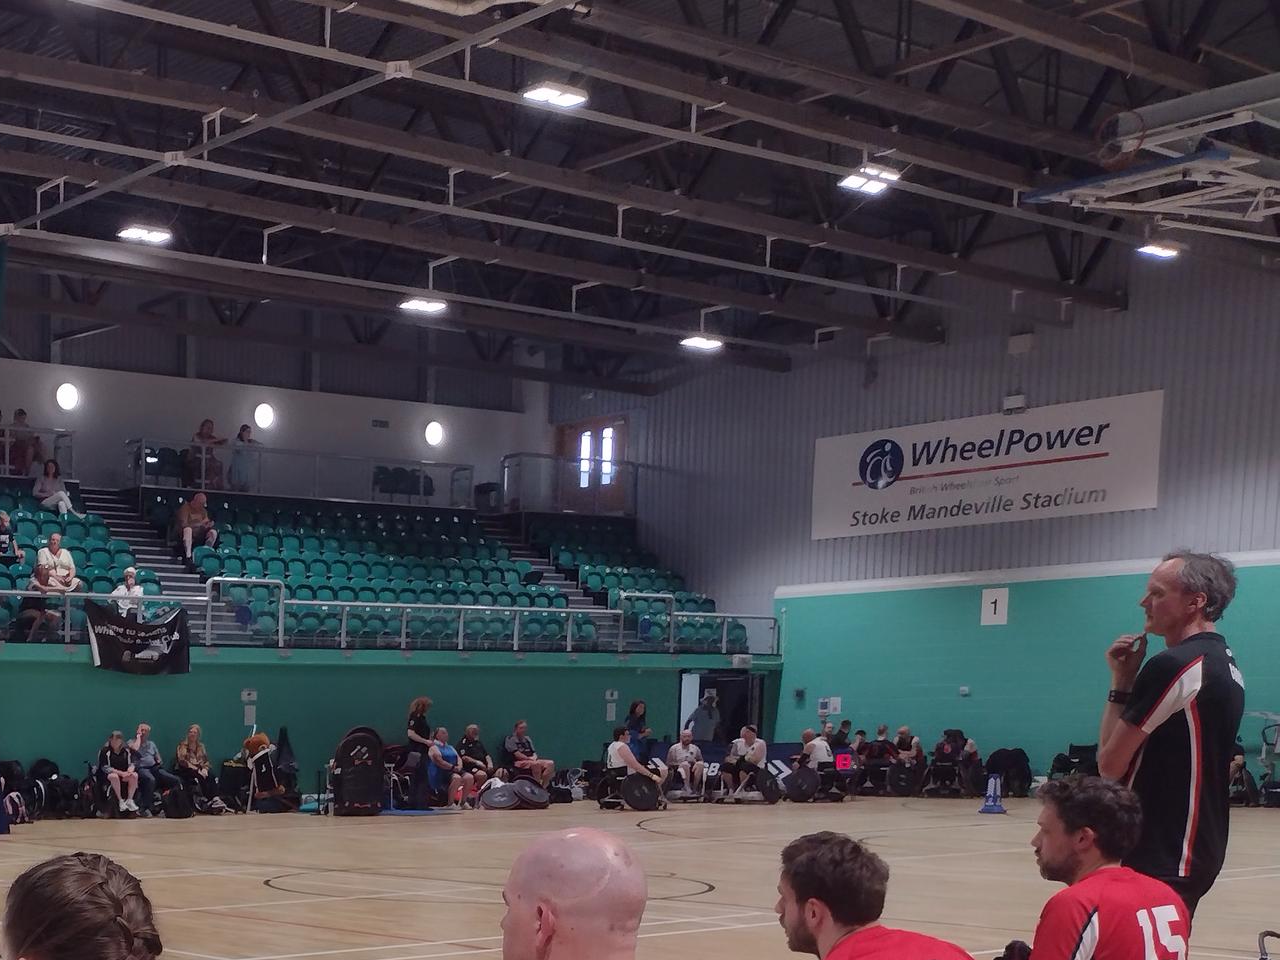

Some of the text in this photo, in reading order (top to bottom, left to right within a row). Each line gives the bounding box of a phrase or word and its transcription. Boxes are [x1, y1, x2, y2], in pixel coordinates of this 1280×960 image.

[910, 422, 1111, 467] WheelPower
[849, 486, 1108, 528] Stoke Mandeville Stadium
[990, 598, 998, 616] 1
